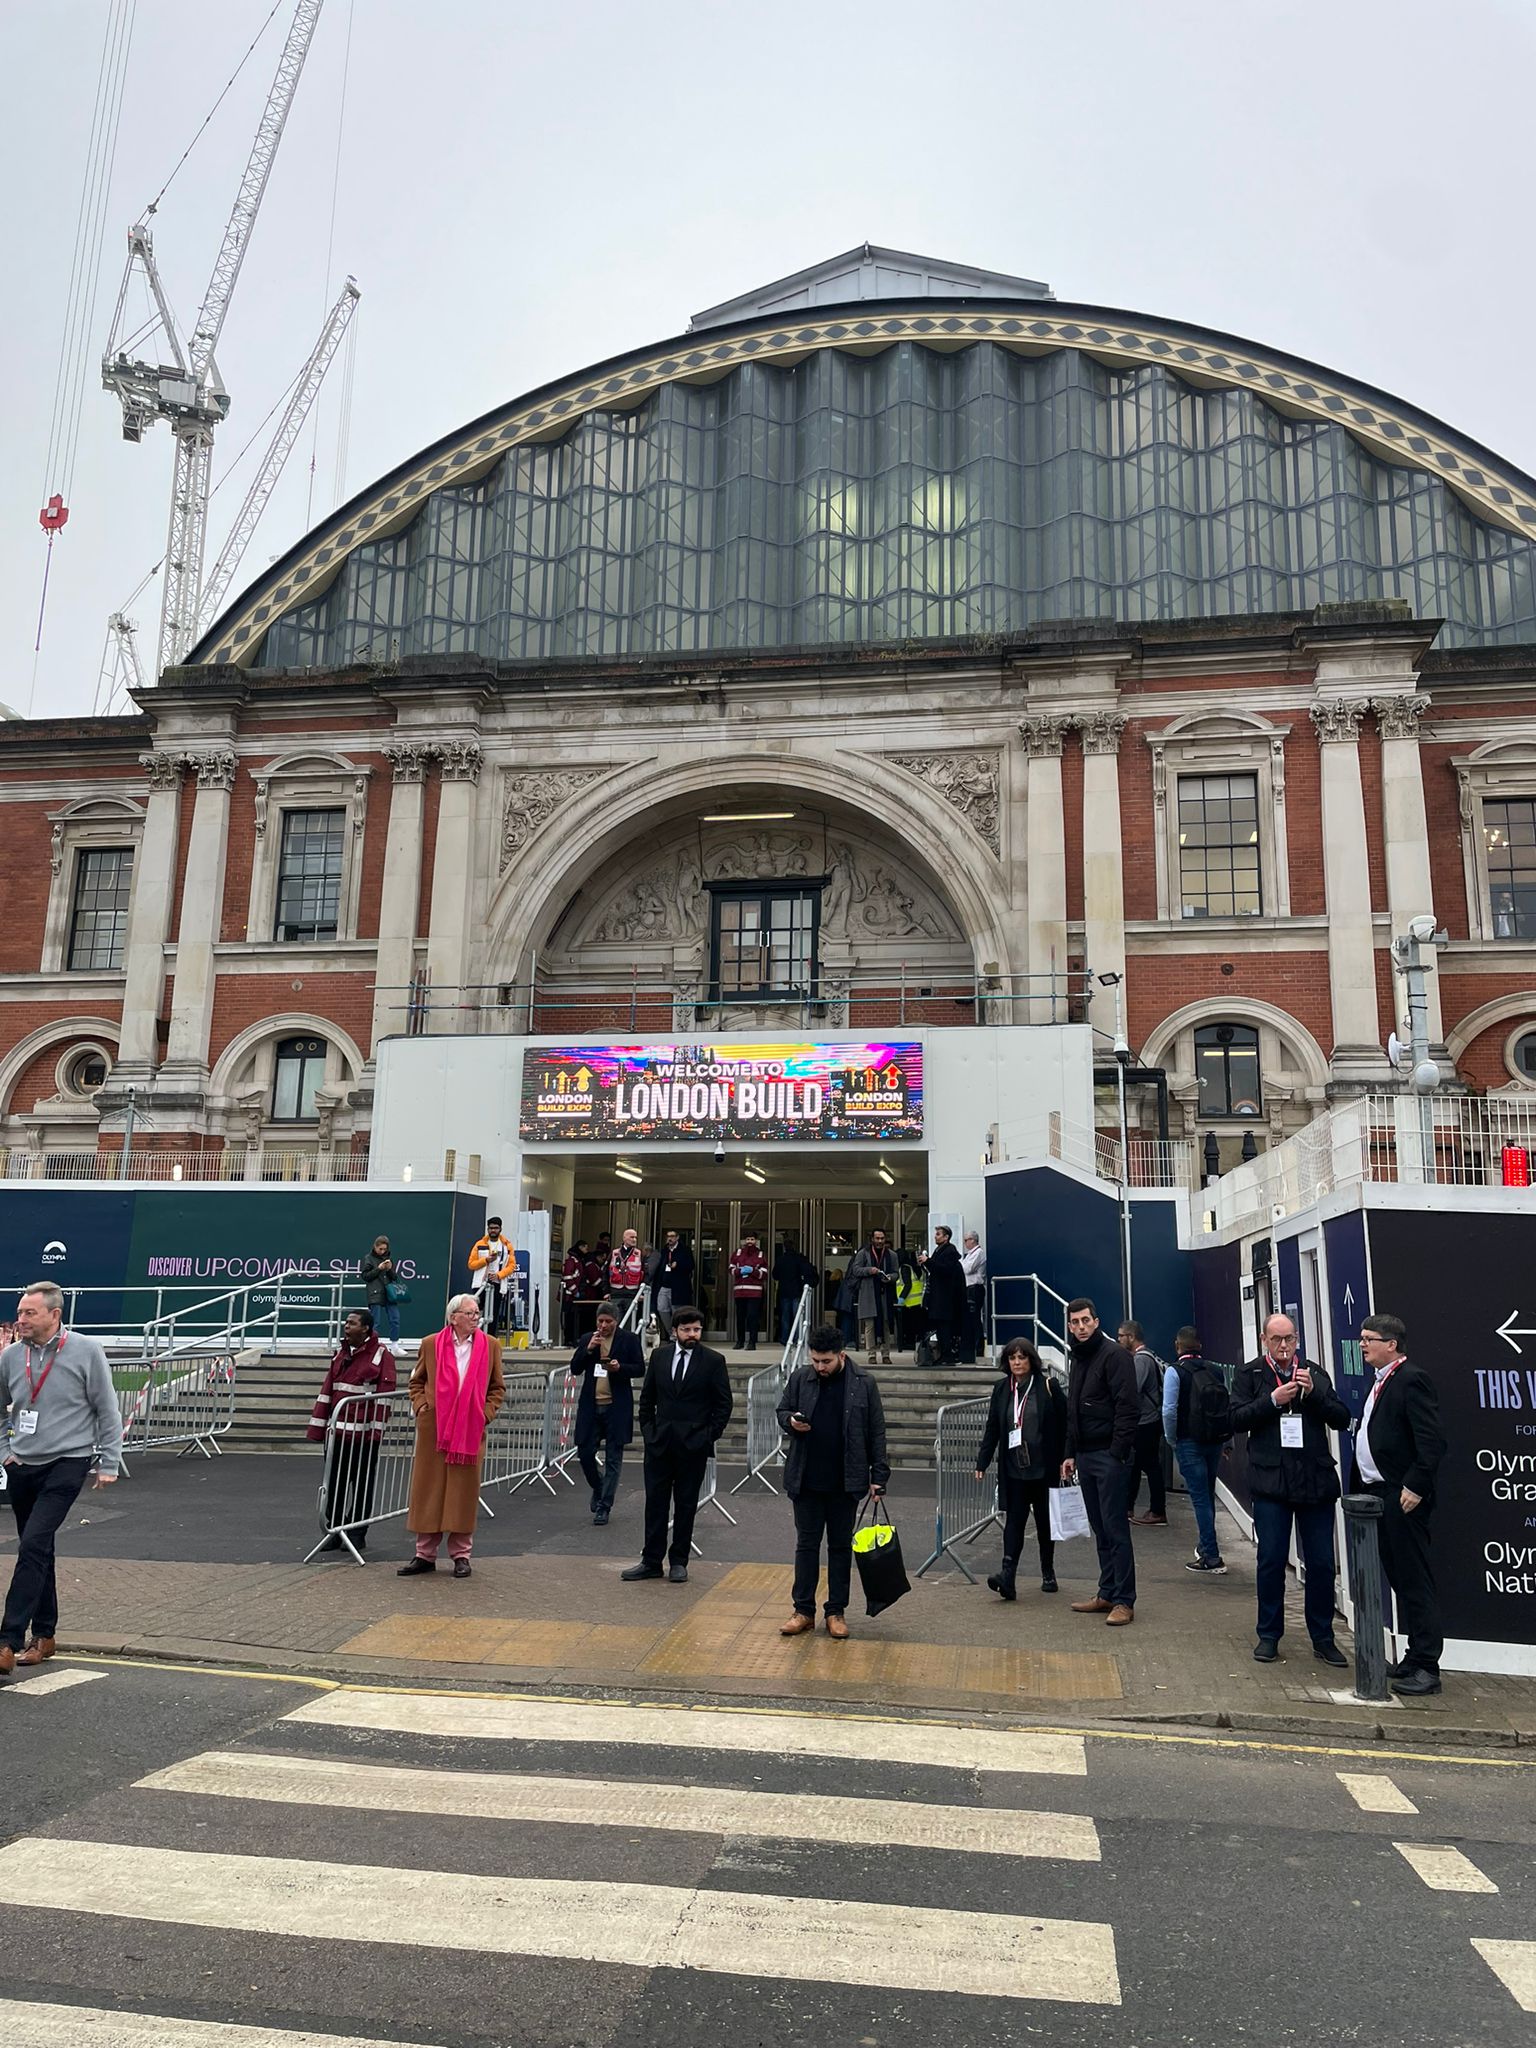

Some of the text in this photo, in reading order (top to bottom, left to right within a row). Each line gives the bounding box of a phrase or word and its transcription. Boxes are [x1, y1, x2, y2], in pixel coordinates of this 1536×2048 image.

[656, 1063, 782, 1077] WELCOME TO
[538, 1094, 593, 1104] LONDON
[615, 1082, 823, 1120] LONDON BUILD
[844, 1092, 904, 1102] LONDON
[537, 1104, 593, 1112] BUILD EXPO
[844, 1102, 903, 1110] BUILD EXPO
[148, 1256, 193, 1277] DISCOVER
[194, 1257, 321, 1278] UPCOMING
[1474, 1369, 1523, 1410] THIS
[1491, 1478, 1536, 1501] Gra
